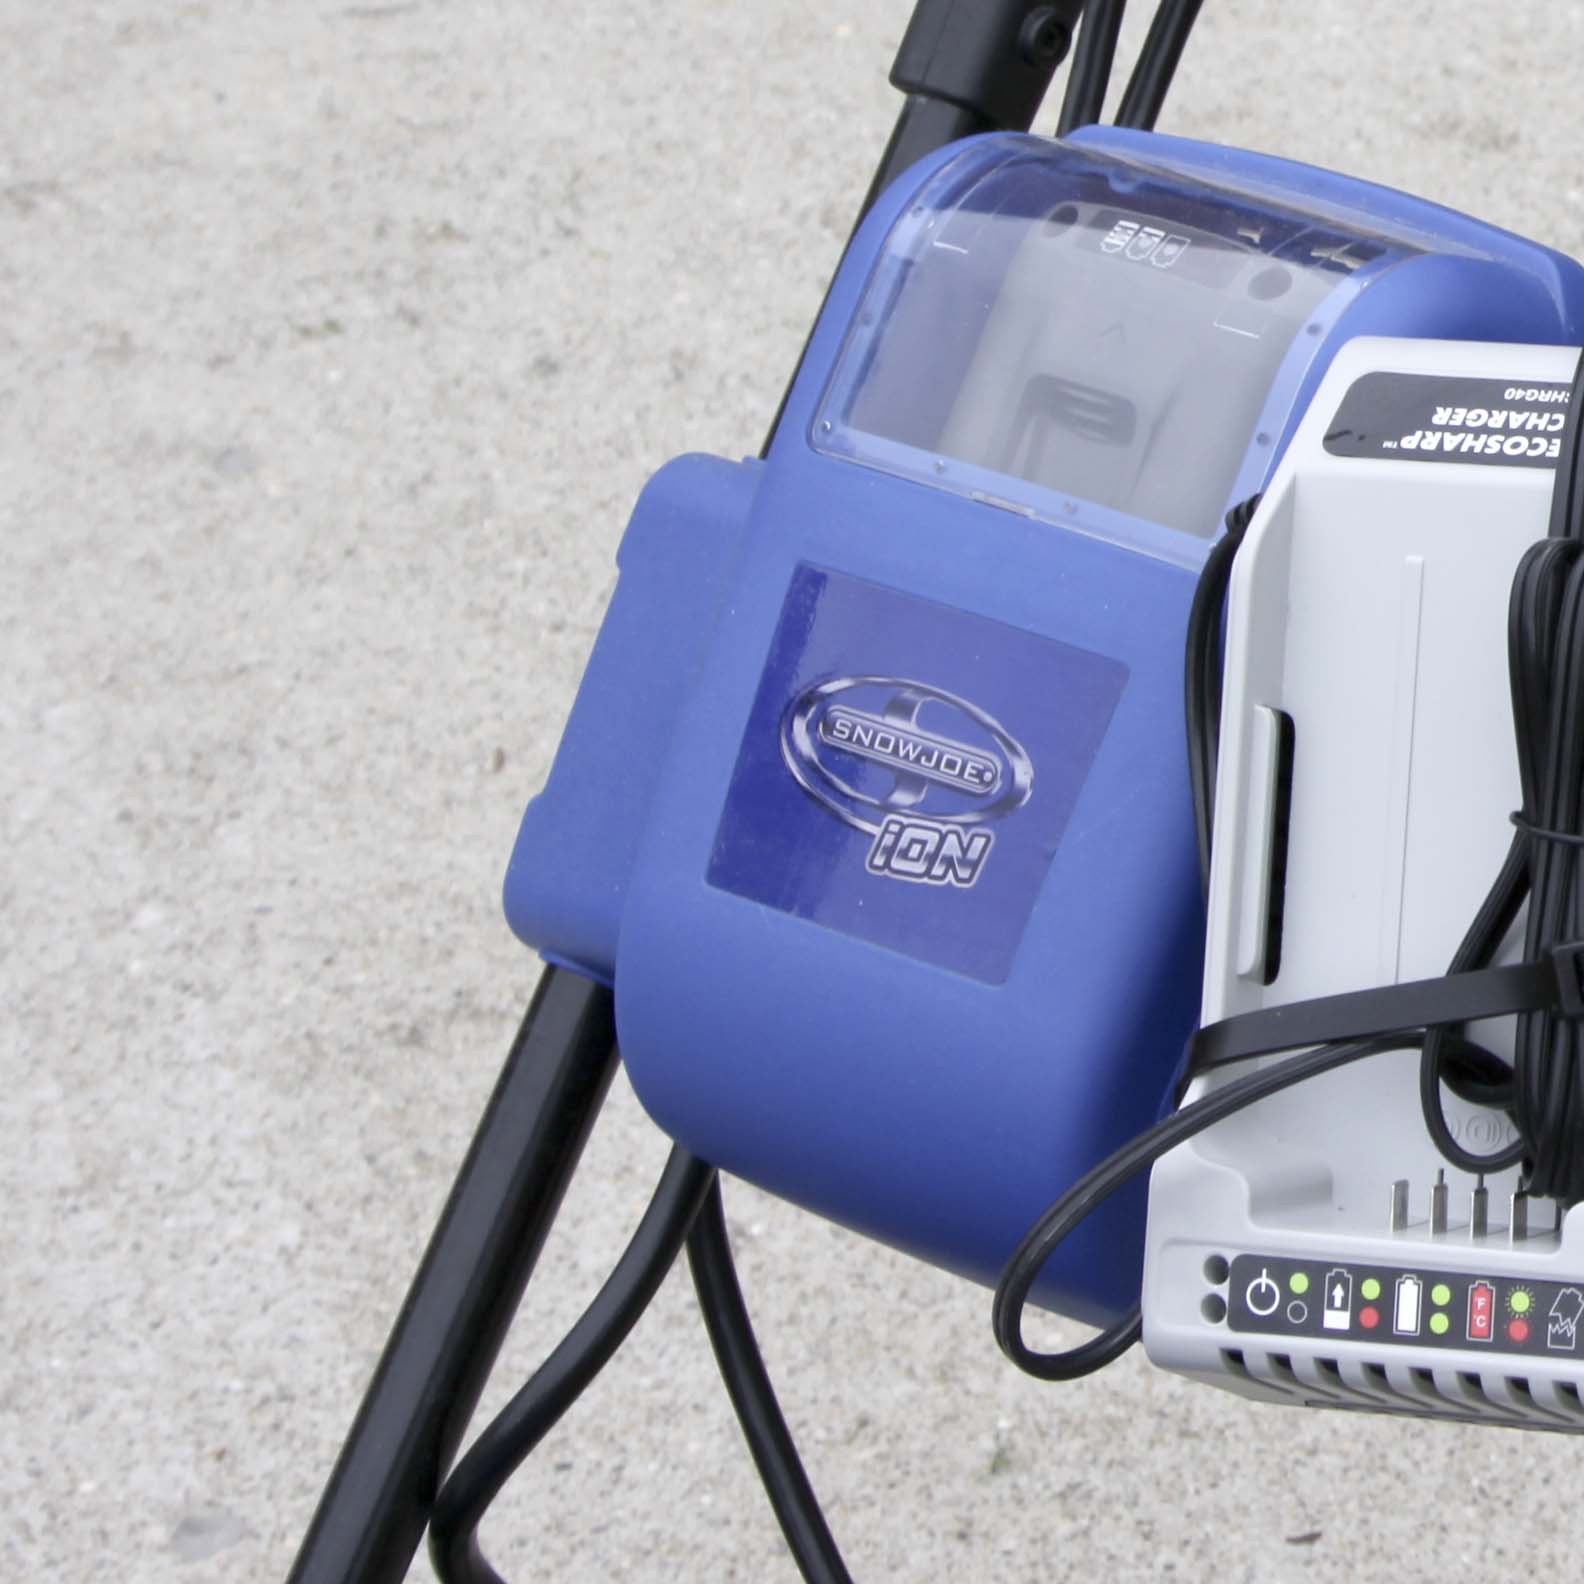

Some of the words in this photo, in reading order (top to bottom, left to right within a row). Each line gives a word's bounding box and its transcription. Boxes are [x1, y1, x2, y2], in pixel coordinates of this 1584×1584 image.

[1503, 387, 1571, 404] HRG40
[1431, 406, 1566, 432] CHARGER
[832, 718, 985, 784] SNOWJOE
